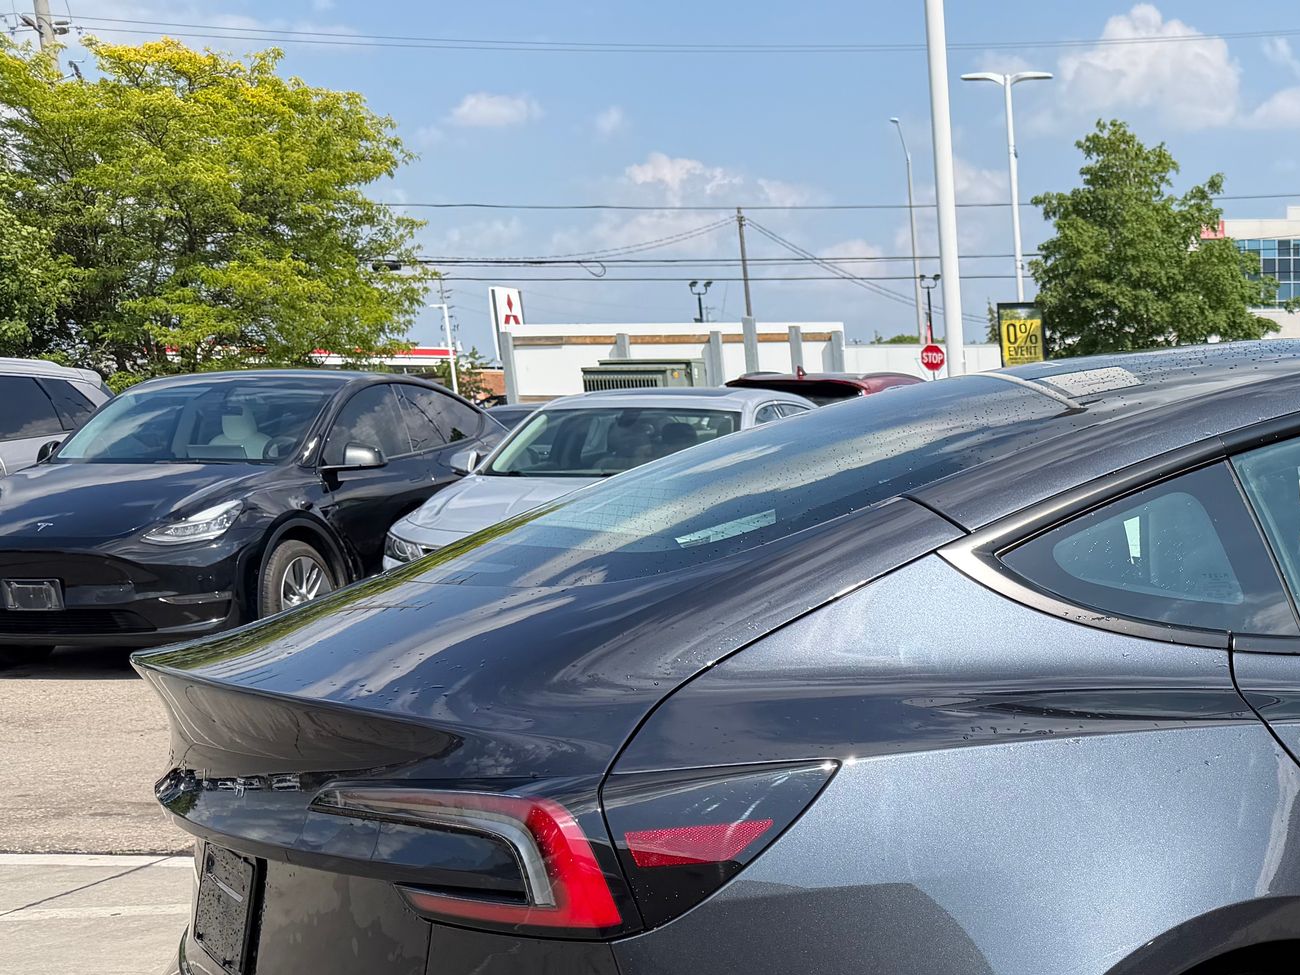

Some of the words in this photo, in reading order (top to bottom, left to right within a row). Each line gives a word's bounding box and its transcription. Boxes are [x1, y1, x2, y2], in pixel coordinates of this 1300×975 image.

[1007, 323, 1037, 345] 0%
[1008, 346, 1037, 356] EVENT
[922, 352, 943, 364] STOP
